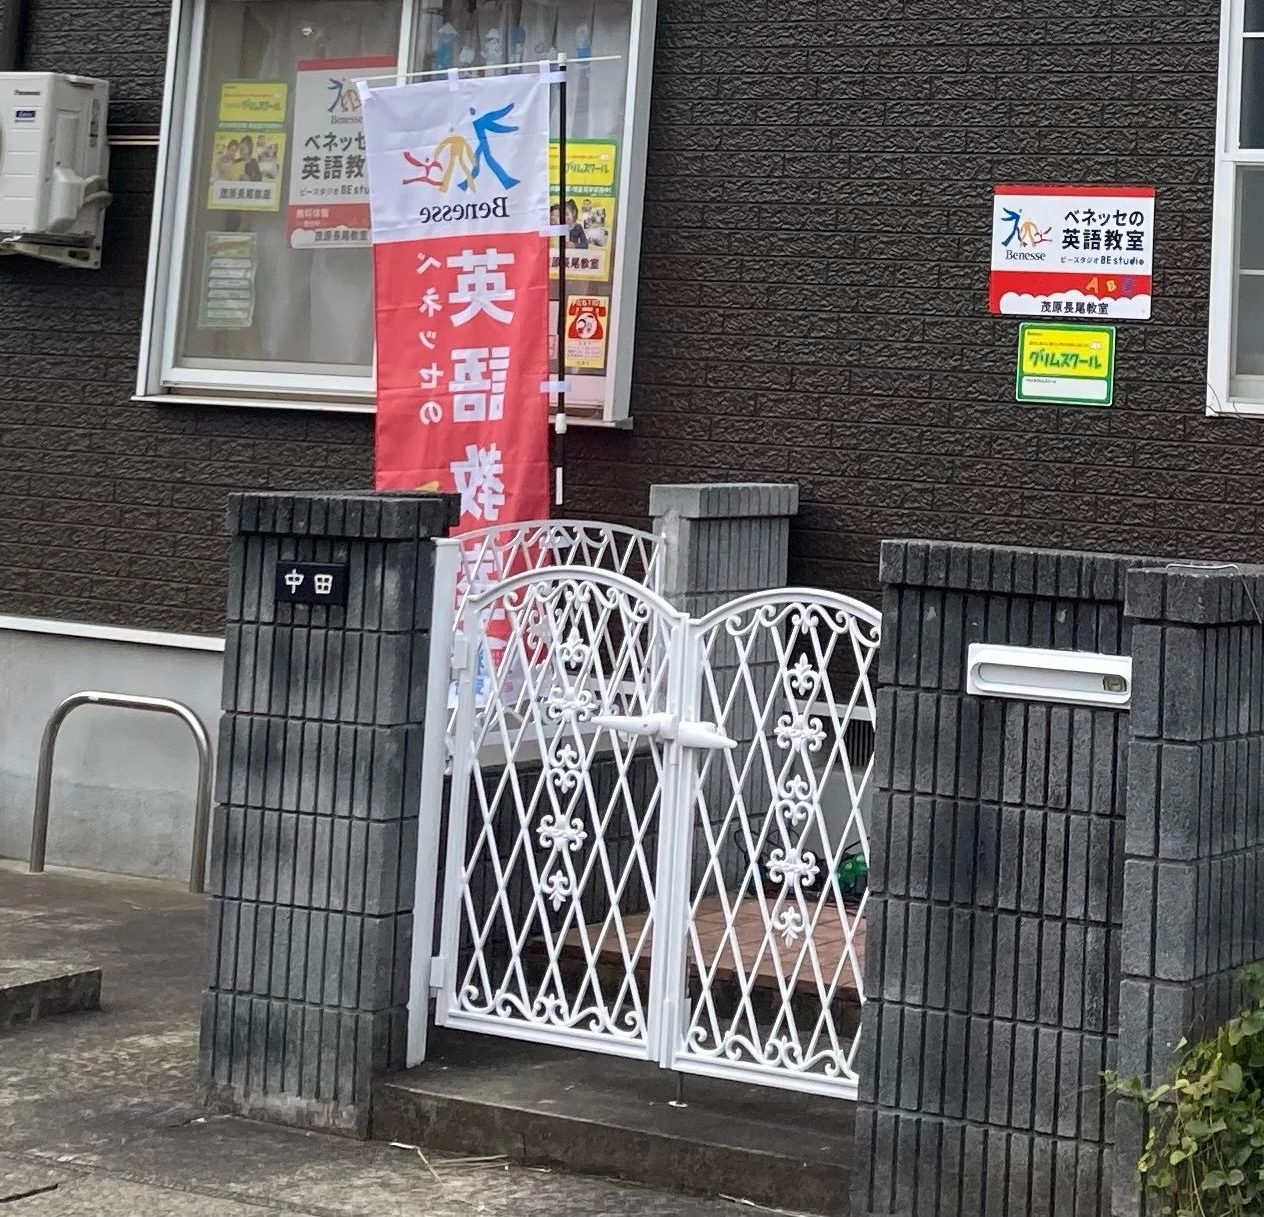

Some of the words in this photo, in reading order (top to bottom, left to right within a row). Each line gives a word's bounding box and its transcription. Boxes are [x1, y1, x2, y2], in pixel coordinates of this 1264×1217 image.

[1064, 208, 1144, 226] ベネッセの
[1062, 228, 1144, 251] 英語教室
[549, 256, 599, 270] 原長尾教室
[1005, 249, 1046, 261] Benesse
[1061, 255, 1099, 264] ビースタジオ
[1101, 255, 1112, 264] BE
[1113, 256, 1145, 265] studio
[1030, 347, 1102, 369] グリムスクール
[285, 569, 333, 594] 中田
